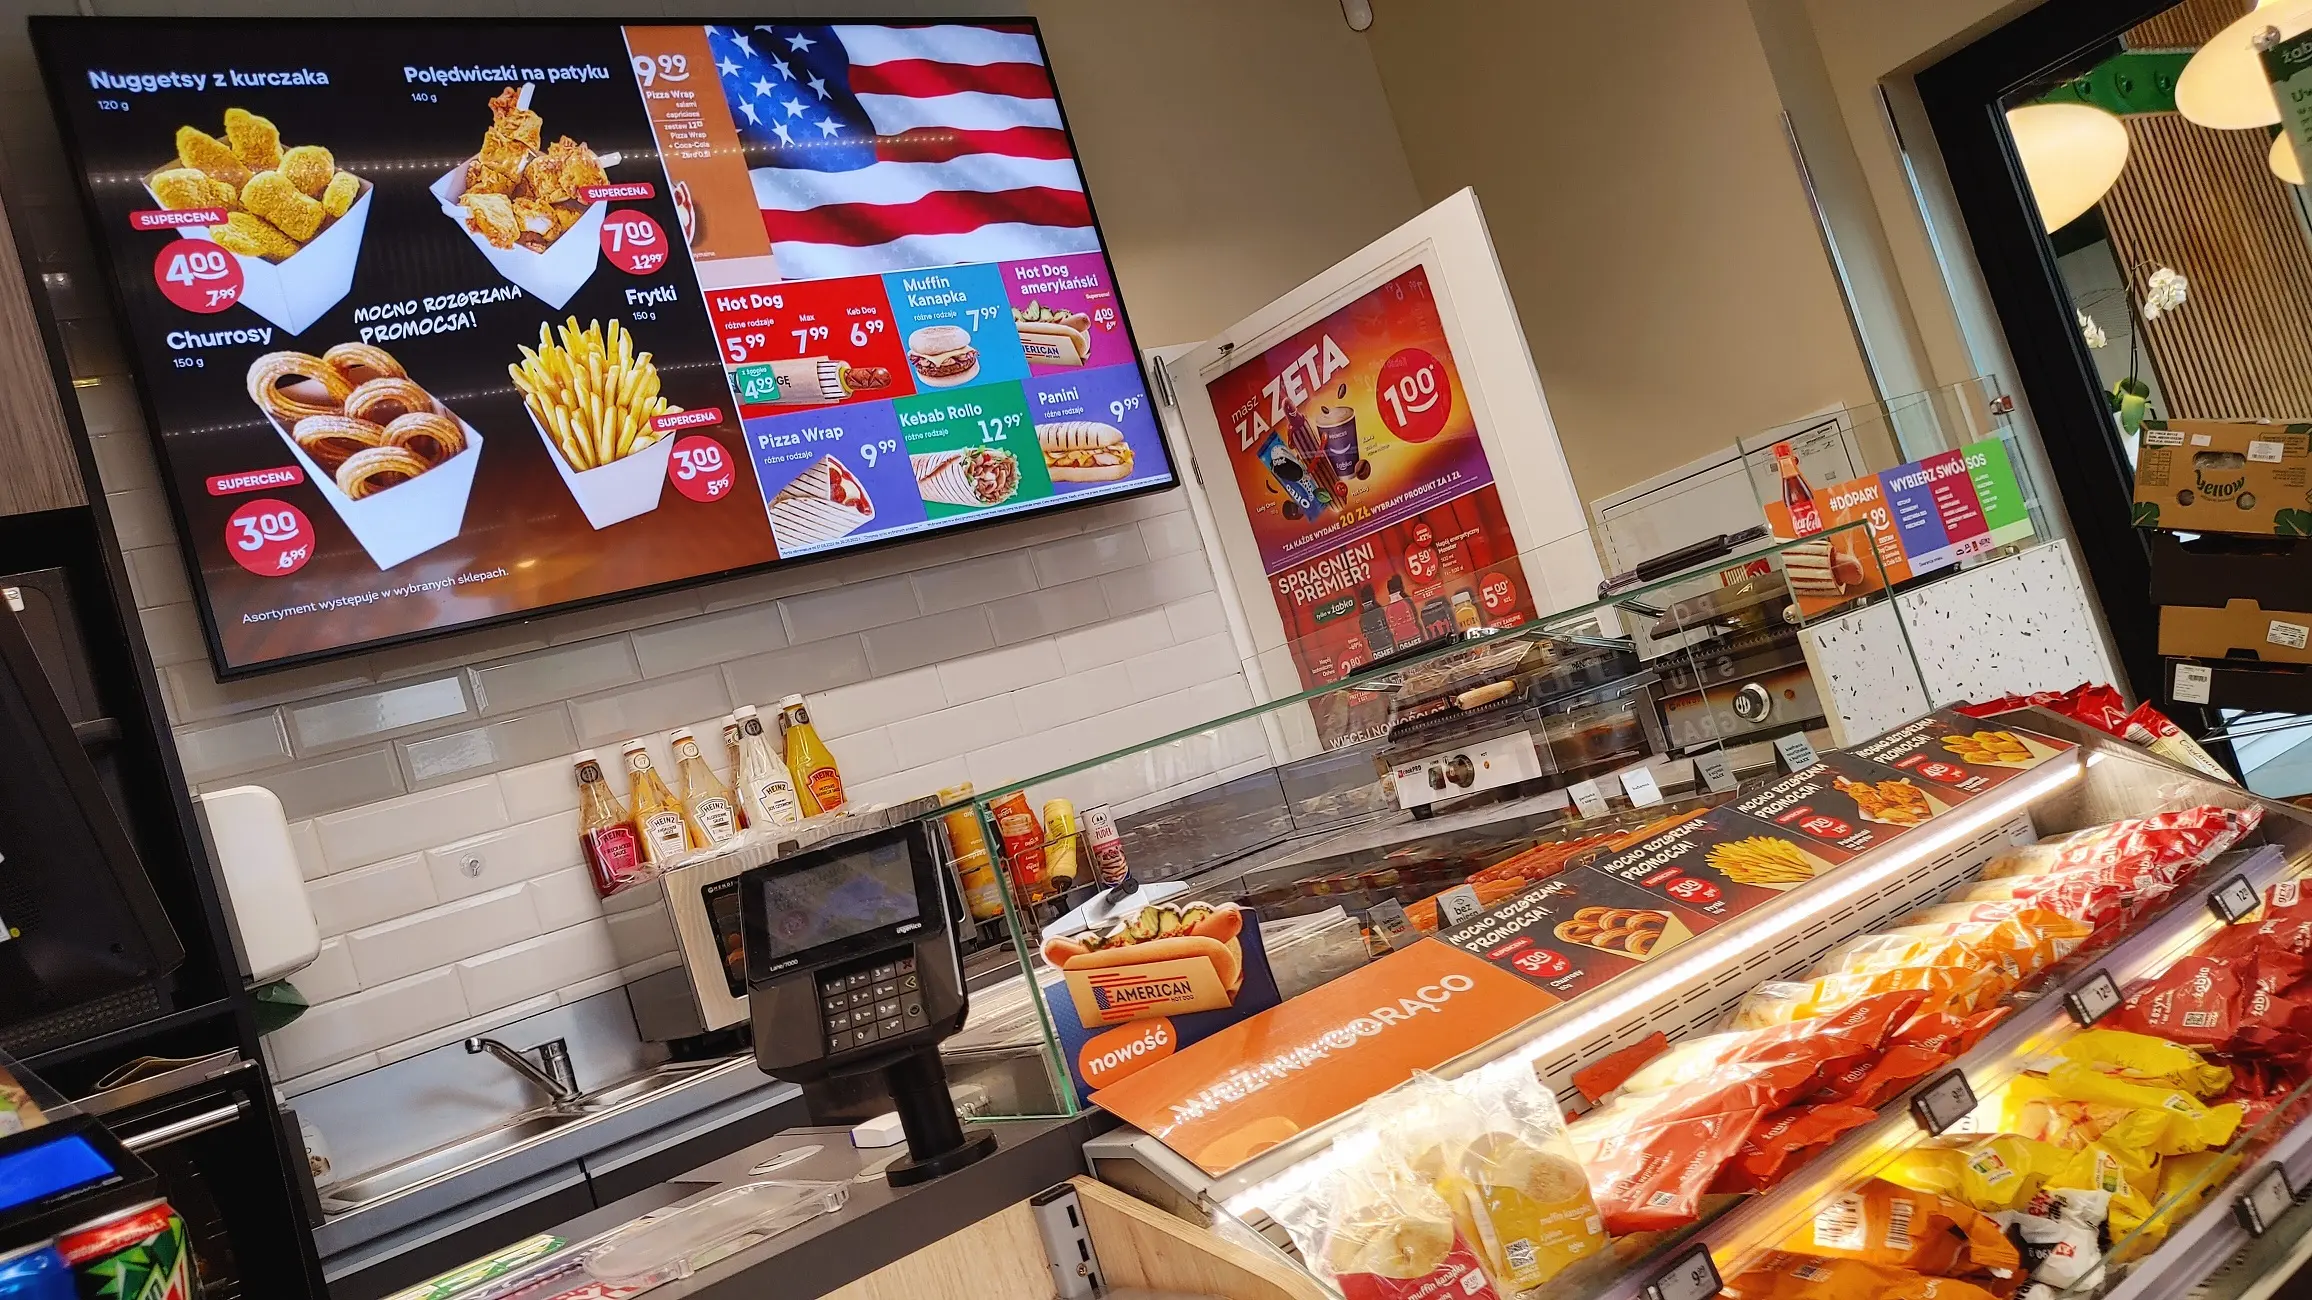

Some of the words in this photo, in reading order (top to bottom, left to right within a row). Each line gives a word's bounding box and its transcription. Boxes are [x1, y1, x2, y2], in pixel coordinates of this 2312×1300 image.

[88, 69, 206, 92] Nuggetsy
[213, 73, 227, 87] z
[230, 67, 329, 86] kurczaka
[404, 65, 518, 86] Polędwiczki
[523, 67, 545, 82] na
[551, 64, 610, 84] patyku
[411, 92, 428, 102] 140
[430, 94, 438, 104] g
[646, 91, 669, 100] Pizza
[671, 90, 694, 99] Wrap
[98, 100, 119, 111] 120
[121, 102, 129, 113] g
[588, 187, 648, 198] SUPERCENA
[141, 212, 219, 226] SUPERCENA
[1015, 267, 1040, 280] Hot
[1043, 263, 1069, 278] Dog
[902, 276, 950, 292] Muffin
[1020, 274, 1099, 295] amerykański
[625, 285, 677, 307] Frytki
[716, 297, 748, 312] Hot
[750, 293, 784, 309] Dog
[908, 290, 967, 308] Kanapka
[353, 300, 417, 324] MOCNO
[632, 311, 648, 320] 150
[649, 312, 656, 322] g
[799, 314, 815, 323] Max
[862, 306, 877, 316] Dog
[360, 314, 477, 345] PROMOCJA!
[725, 322, 746, 331] różne
[747, 318, 774, 328] rodzaje
[166, 327, 272, 350] Churrosy
[173, 357, 194, 368] 150
[196, 358, 204, 368] g
[1037, 386, 1079, 405] Panini
[1234, 411, 1271, 452] ZA
[1262, 333, 1350, 426] ZETA
[657, 412, 716, 428] SUPERCENA
[900, 408, 945, 428] Kebab
[948, 403, 983, 420] Rollo
[1231, 395, 1259, 424] masz
[758, 432, 801, 450] Pizza
[802, 426, 844, 443] Wrap
[217, 471, 295, 491] SUPERCENA
[1889, 468, 1937, 493] WYBIERZ
[1936, 458, 1966, 479] SWÓJ
[1966, 453, 1987, 470] SOS
[2194, 469, 2246, 498] yellow
[1829, 484, 1879, 512] #DOPARY
[1295, 533, 1315, 548] KAŻDE
[1314, 522, 1341, 540] WYDANE
[1340, 513, 1356, 529] 20
[1356, 505, 1372, 523] ZŁ
[1371, 494, 1404, 516] WYBRANY
[1404, 481, 1437, 503] PRODUKT
[1437, 477, 1448, 490] ZA
[1452, 471, 1462, 483] ZŁ
[1278, 542, 1375, 596] SPRAGNIENI
[242, 601, 317, 624] Asortyment
[319, 591, 380, 615] występuje
[381, 589, 391, 599] w
[394, 576, 456, 598] wybranych
[458, 566, 509, 588] sklepach.
[1294, 564, 1372, 606] PREMIER?
[814, 770, 834, 781] HEINZ
[766, 783, 786, 795] HEINZ
[703, 801, 725, 813] HEINZ
[1737, 792, 1776, 815] MOCNO
[653, 815, 676, 828] HEINZ
[603, 829, 627, 844] HEINZ
[1602, 849, 1647, 874] MOCNO
[1620, 840, 1698, 881] PROMOCJA!
[1453, 903, 1472, 915] bez
[1447, 916, 1496, 947] MOCNO
[1465, 906, 1554, 954] PROMOCJA!
[1116, 981, 1192, 1003] AMERICAN
[1326, 972, 1476, 1050] GORĄCO
[1088, 1024, 1169, 1075] nowość
[1407, 1282, 1437, 1300] muffin
[1435, 1263, 1467, 1288] kanapka
